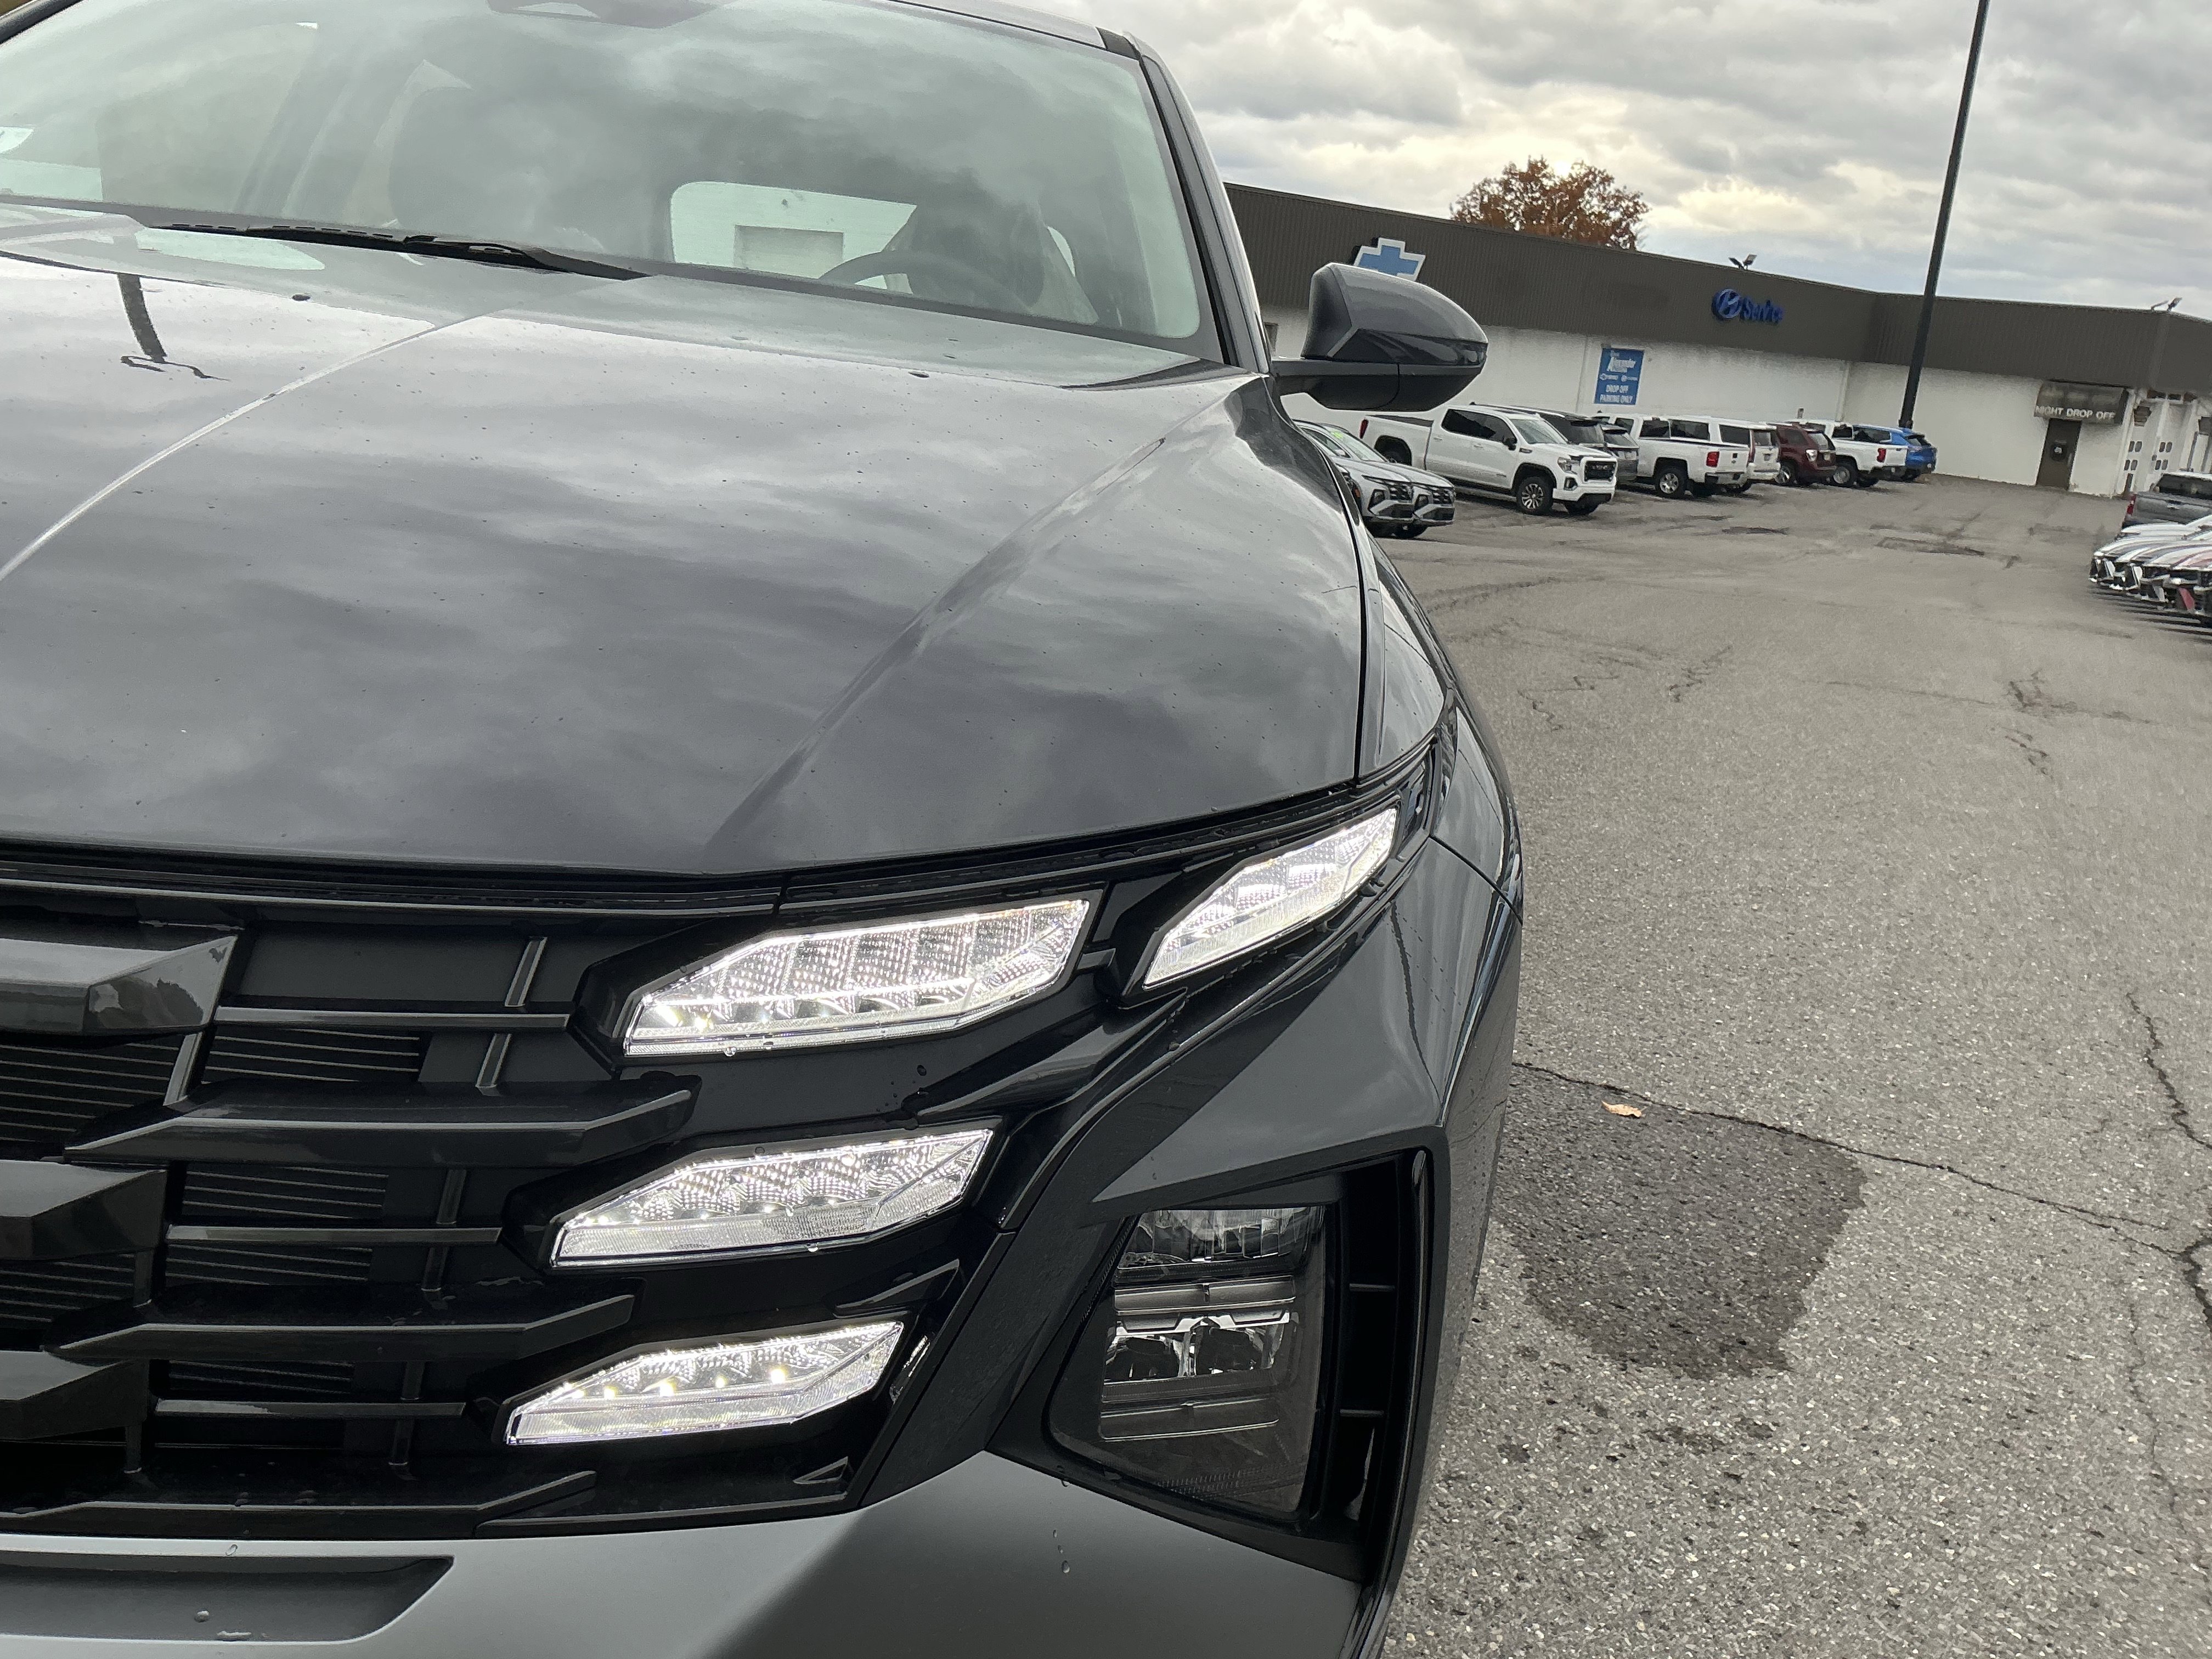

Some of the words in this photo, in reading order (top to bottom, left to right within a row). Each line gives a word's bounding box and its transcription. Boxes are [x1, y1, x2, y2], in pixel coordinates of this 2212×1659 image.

[2035, 405, 2064, 415] NIGHT
[2066, 408, 2093, 418] DROP
[2096, 411, 2116, 420] OFF
